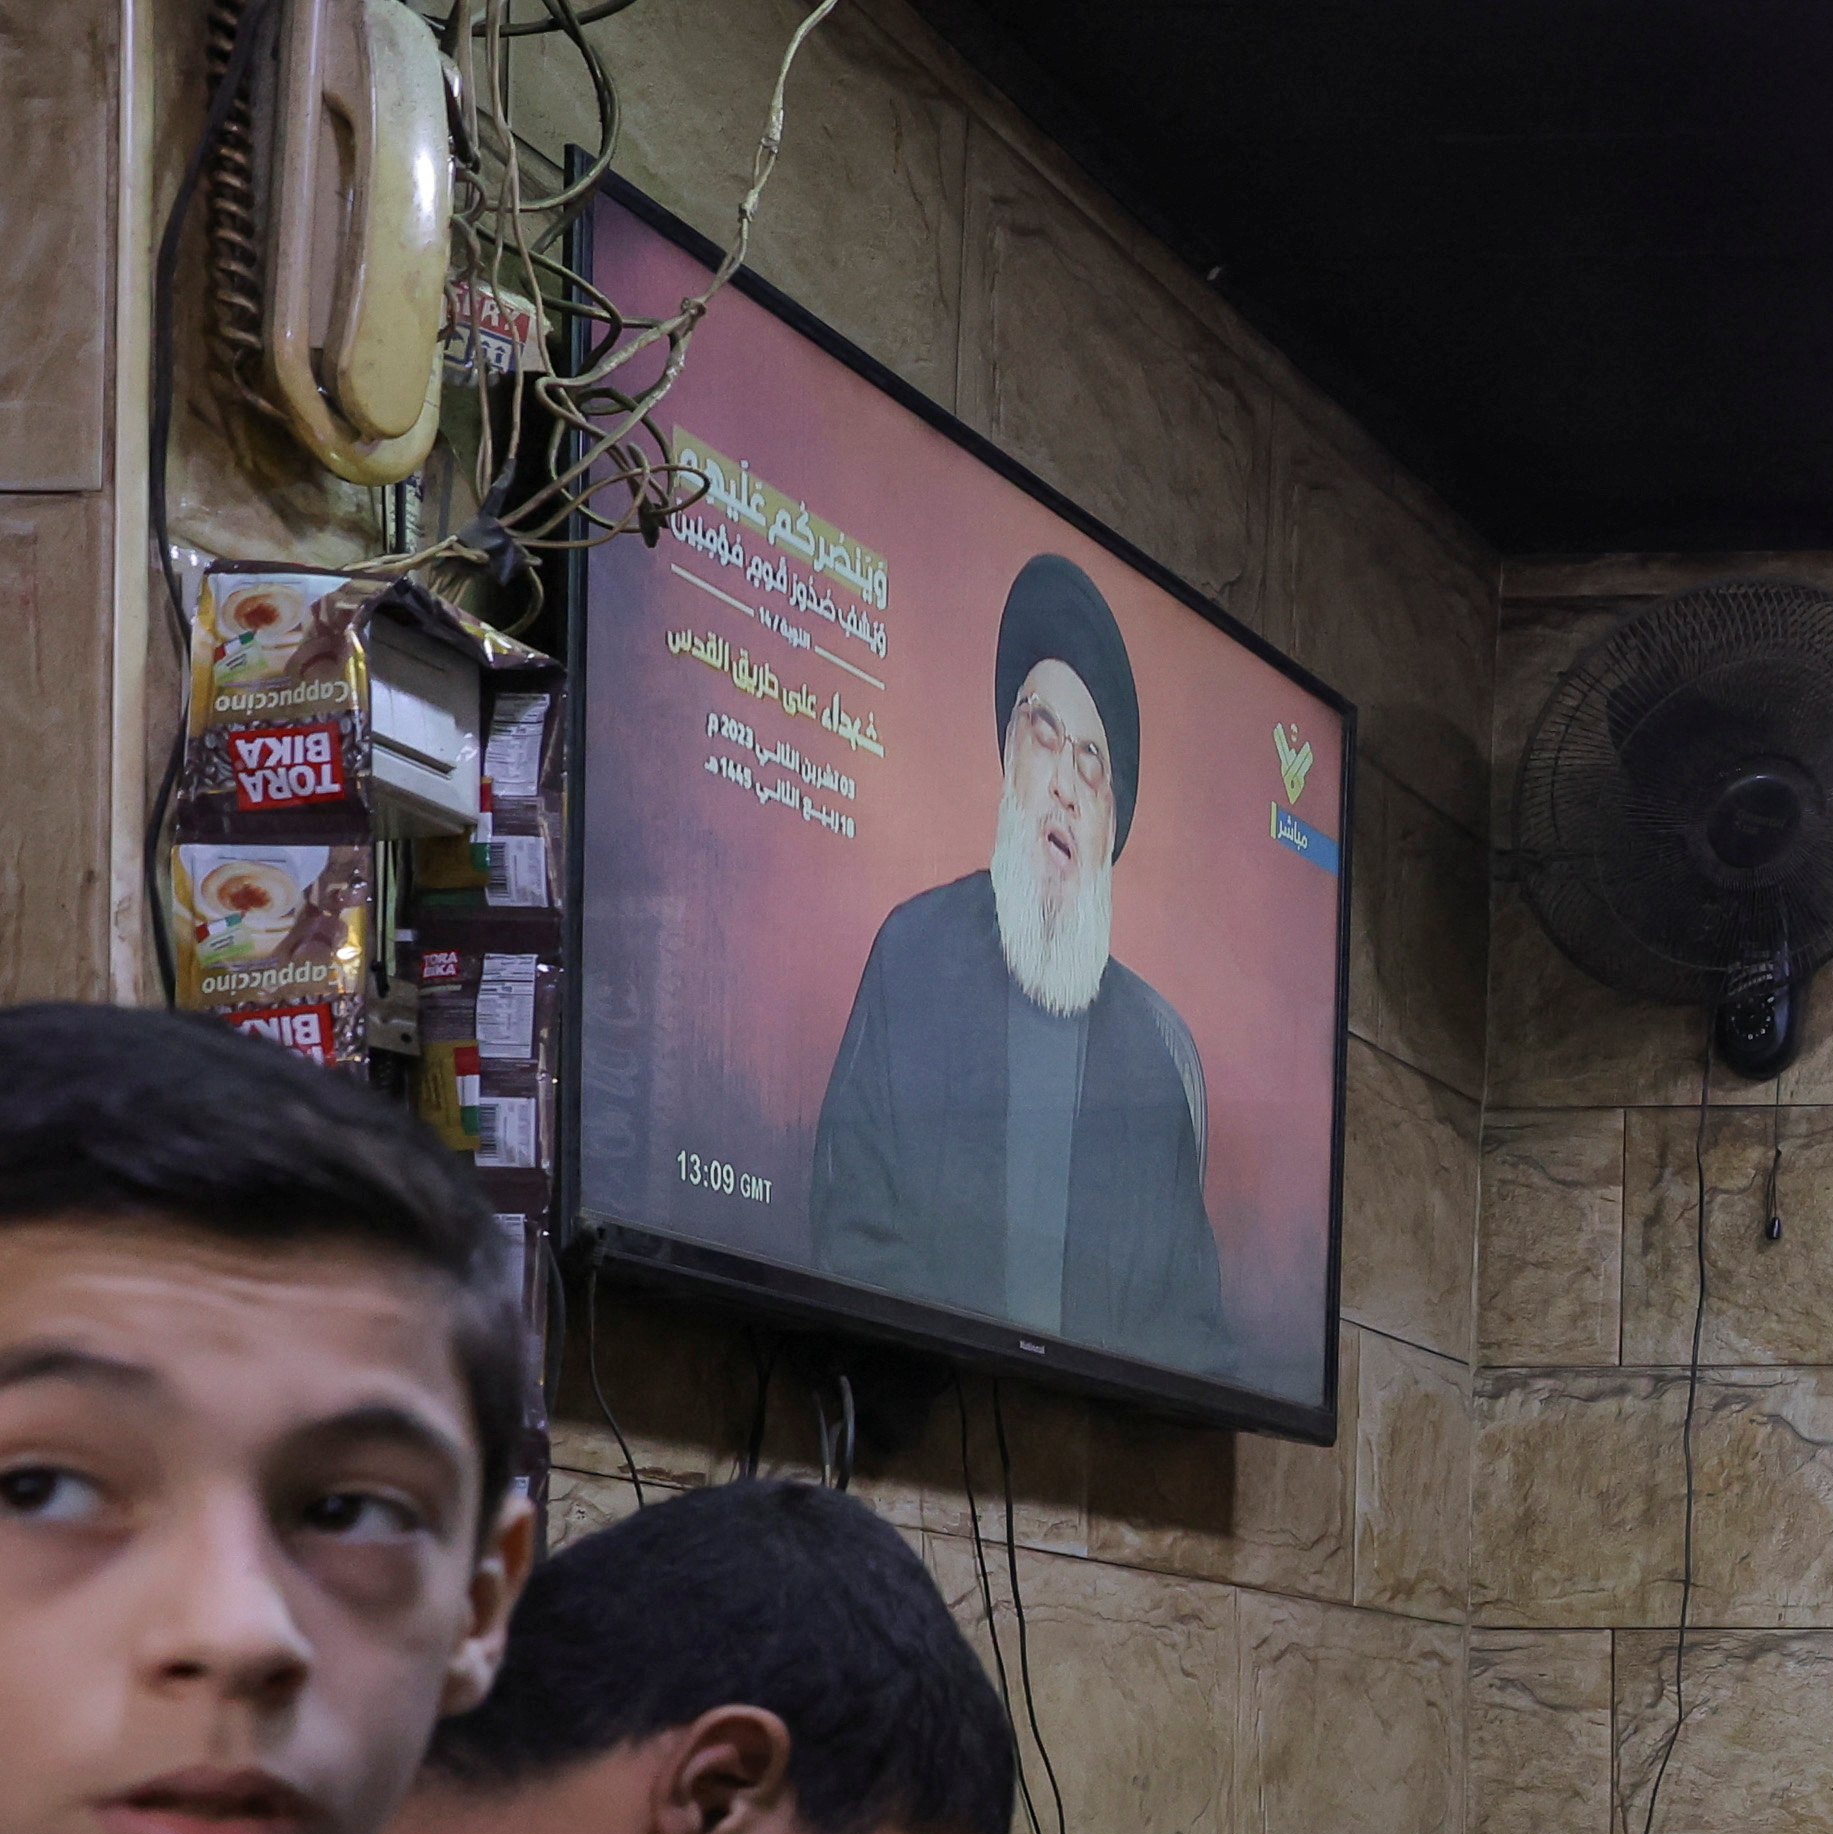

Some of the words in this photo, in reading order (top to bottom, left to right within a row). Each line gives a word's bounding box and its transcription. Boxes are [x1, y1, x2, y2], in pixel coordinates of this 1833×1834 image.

[667, 629, 730, 672] القدس
[731, 648, 780, 699] طريق
[214, 680, 351, 716] Cappuccino
[782, 683, 818, 719] على
[235, 731, 332, 770] BIKA
[721, 714, 754, 750] 2023
[238, 763, 343, 804] TORA
[1277, 814, 1310, 851] مباشر
[677, 1150, 735, 1195] 13:09
[740, 1172, 772, 1204] GMT
